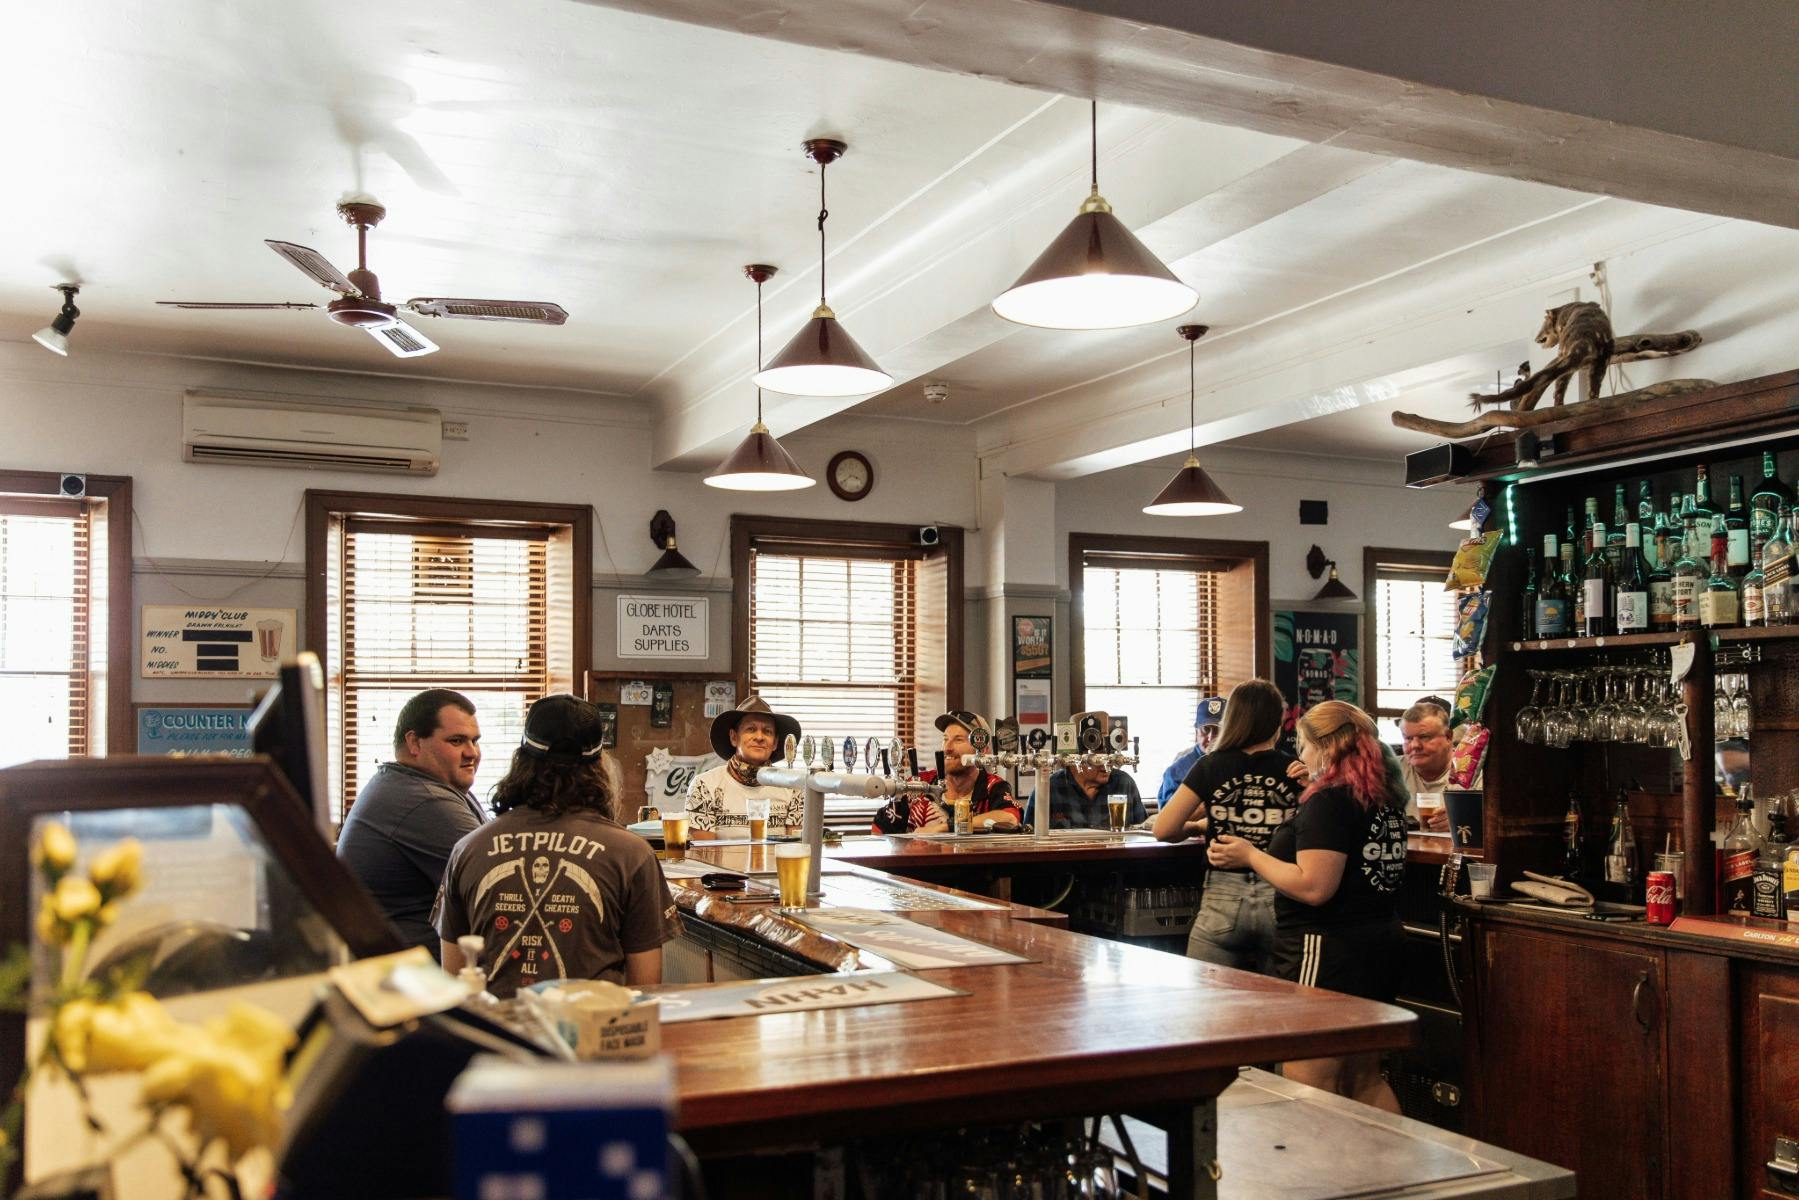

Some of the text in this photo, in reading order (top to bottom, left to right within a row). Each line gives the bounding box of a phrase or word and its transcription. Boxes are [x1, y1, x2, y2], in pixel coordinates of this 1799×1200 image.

[221, 612, 248, 620] CLUB
[626, 603, 697, 619] GLOBE HOTEL
[146, 630, 180, 638] WINNER
[642, 624, 682, 637] DARTS
[634, 639, 690, 652] SUPPLIES
[1018, 636, 1044, 645] WORTH
[146, 661, 180, 669] MIDDIES
[162, 714, 234, 729] COUNTER
[1210, 805, 1297, 825] GLOBE
[1236, 825, 1272, 834] HOTEL
[488, 832, 605, 859] JETPILOT
[499, 893, 576, 903] THRILL DEATH
[495, 903, 580, 914] SEEKERS CHEATERS
[522, 935, 542, 946] RISK
[1744, 930, 1777, 941] CARLTON
[527, 949, 536, 961] IT
[521, 963, 538, 974] ALL
[742, 979, 888, 1009] HAHN
[600, 1035, 645, 1050] FACE MASK
